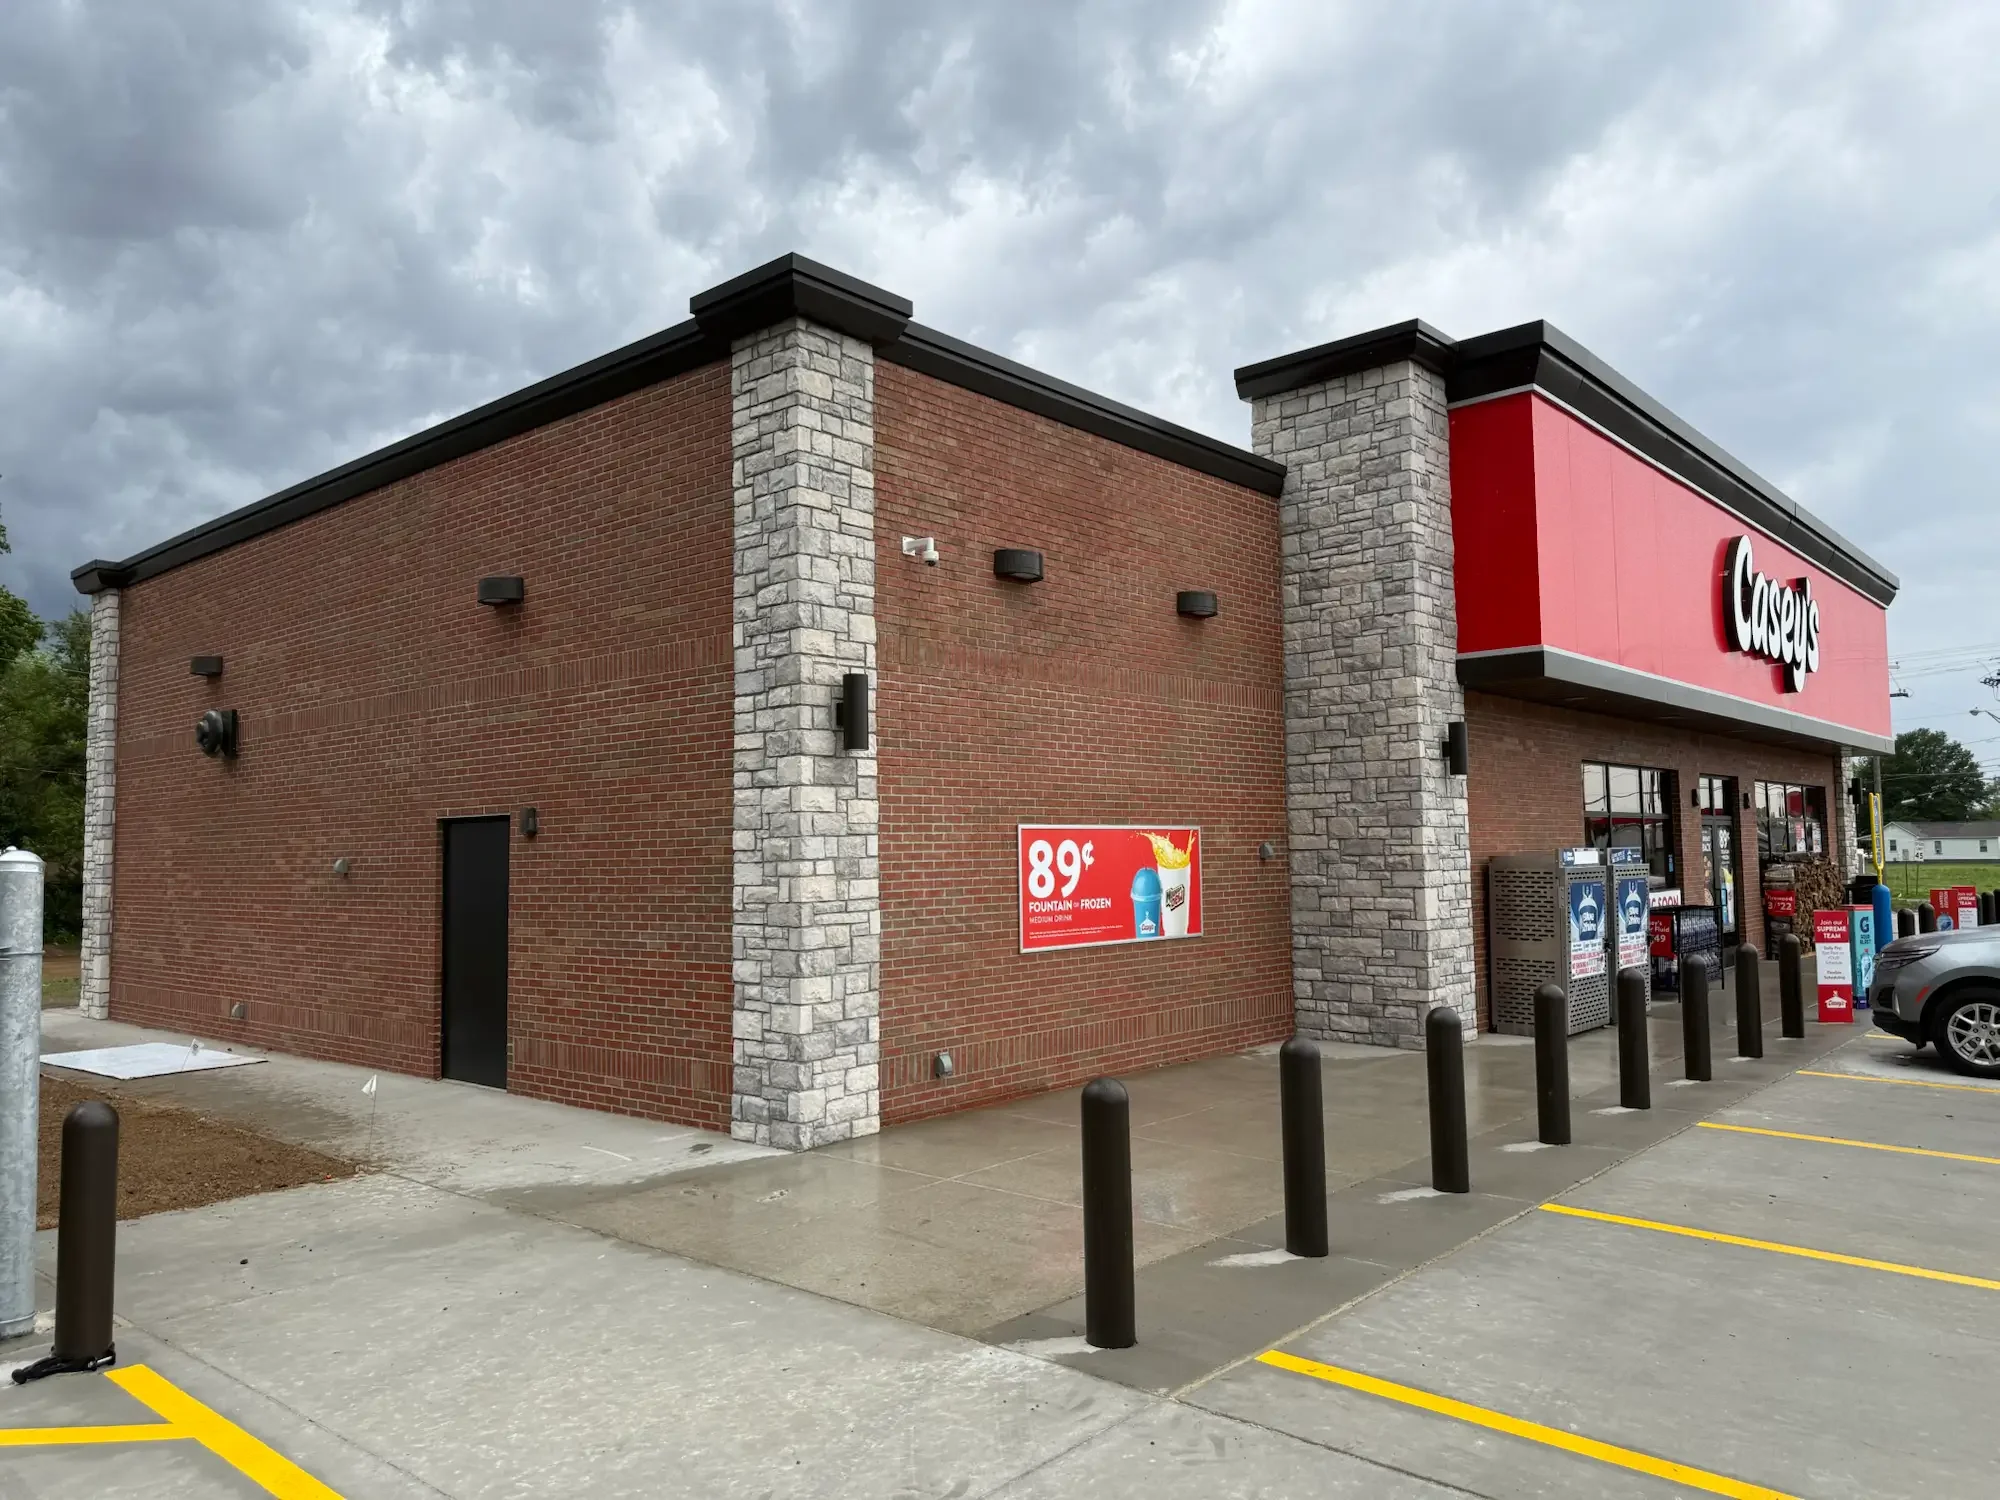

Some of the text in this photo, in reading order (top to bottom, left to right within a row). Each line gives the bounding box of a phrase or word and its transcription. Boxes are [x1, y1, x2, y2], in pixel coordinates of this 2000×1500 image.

[1732, 534, 1820, 693] Casey's
[1028, 839, 1095, 899] 89¢
[1029, 900, 1073, 913] FOUNTAIN
[1080, 897, 1112, 910] FROZEN
[1029, 914, 1073, 924] MEDIUM DRINK
[1859, 916, 1870, 933] G
[1654, 934, 1666, 942] 49
